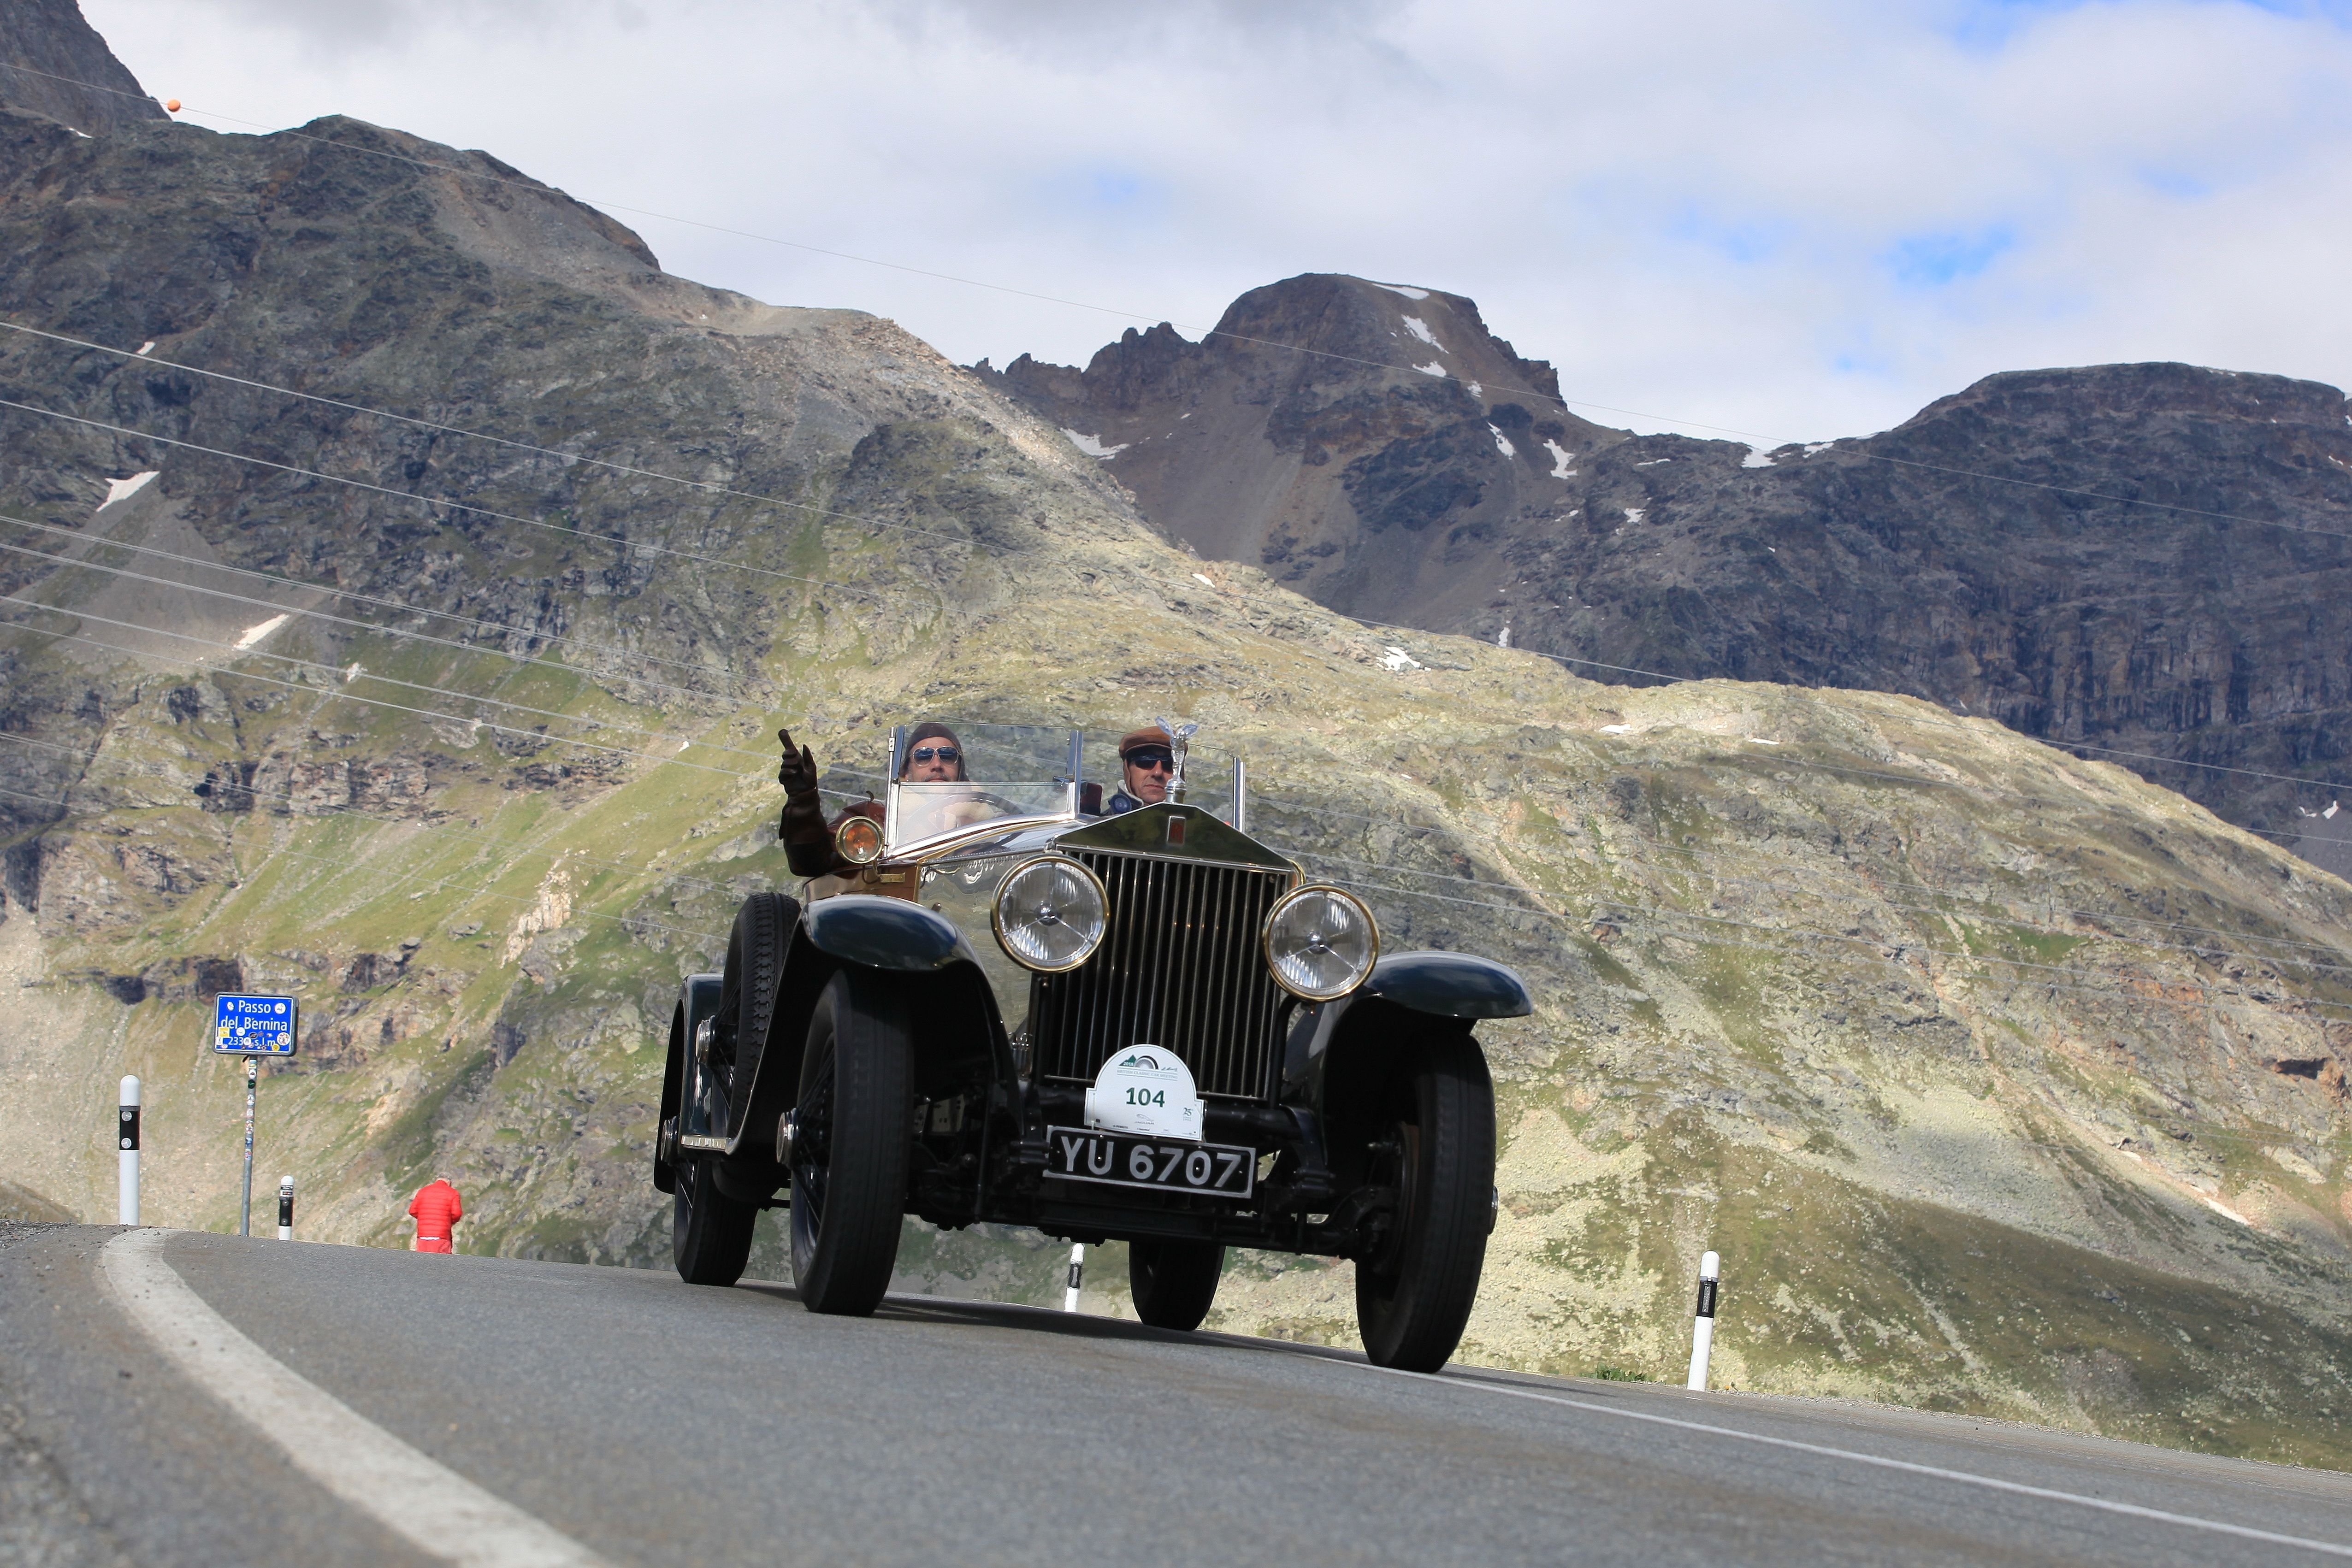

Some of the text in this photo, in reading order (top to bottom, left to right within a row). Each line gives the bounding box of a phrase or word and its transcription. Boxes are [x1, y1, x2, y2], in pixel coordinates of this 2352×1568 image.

[239, 1000, 272, 1014] Passo
[221, 1015, 288, 1031] del Bernina
[1126, 1087, 1165, 1107] 104
[1061, 1136, 1241, 1187] YU 6707
